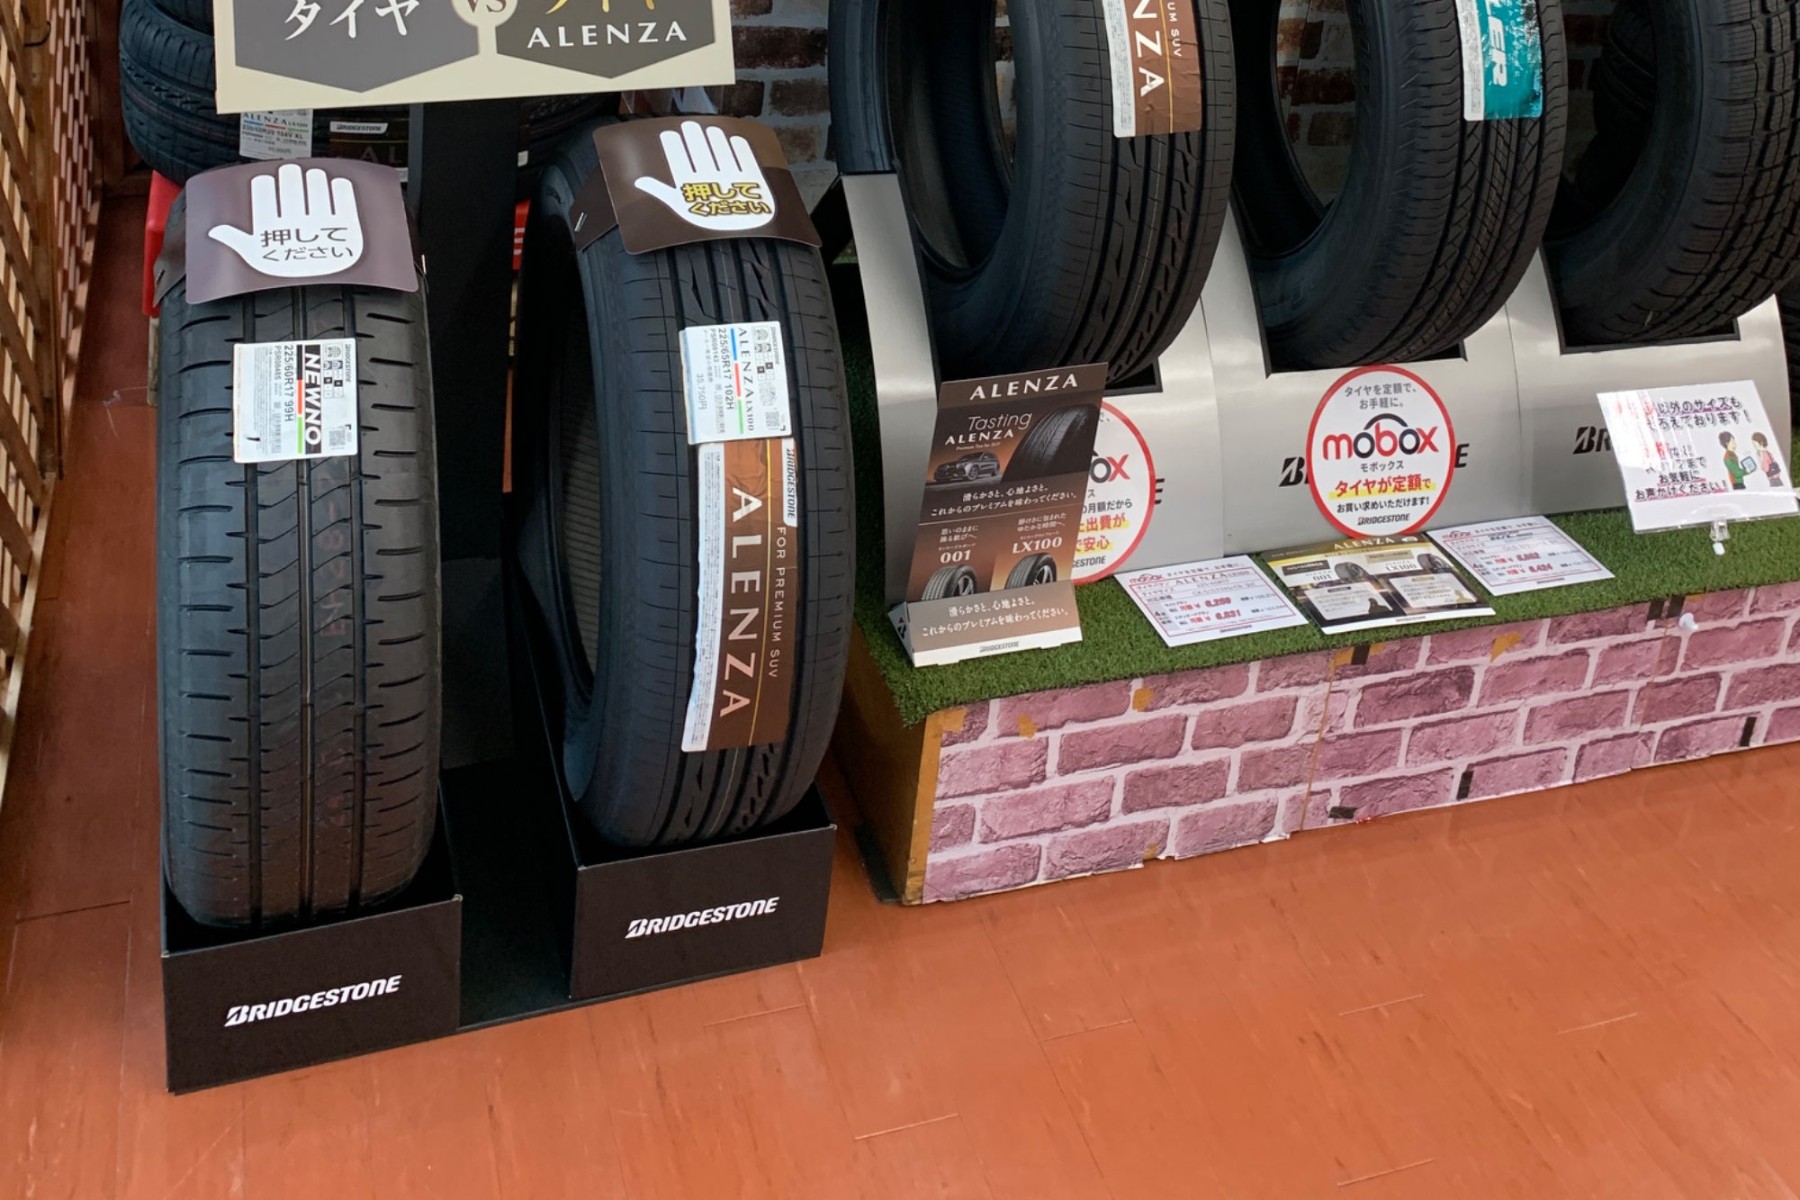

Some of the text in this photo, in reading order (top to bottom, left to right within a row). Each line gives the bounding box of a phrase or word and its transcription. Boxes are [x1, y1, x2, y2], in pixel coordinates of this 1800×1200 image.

[526, 21, 688, 49] ALENZA
[1170, 27, 1182, 57] SUV
[242, 111, 288, 126] ALENZA
[681, 181, 763, 203] 押して
[688, 200, 773, 217] ください
[260, 226, 349, 248] 押して
[261, 246, 354, 262] ください
[738, 326, 755, 399] ALENZA
[283, 344, 295, 423] 225/60R17 99H
[970, 373, 1079, 402] ALENZA
[1344, 382, 1417, 398] タイヤを定額で、
[304, 352, 322, 446] NEWNO
[1359, 397, 1405, 410] お手軽に。
[968, 412, 1033, 432] Tasting
[945, 428, 1015, 446] ALENZA
[1322, 420, 1439, 460] mobox
[1360, 460, 1405, 472] モボックス
[786, 446, 797, 519] BRIDGESTONE
[1335, 474, 1431, 498] タイヤが定額で
[1357, 513, 1411, 526] BRIDGESTONE
[1012, 536, 1063, 554] LX100
[1333, 537, 1397, 550] ALENZA
[940, 550, 972, 564] 001
[1175, 572, 1228, 586] ALENZA
[719, 486, 764, 718] ALENZA
[767, 525, 788, 679] FOR PREMIUM SUV
[623, 896, 781, 941] BRIDGESTONE
[224, 974, 403, 1029] BRIDGESTONE
